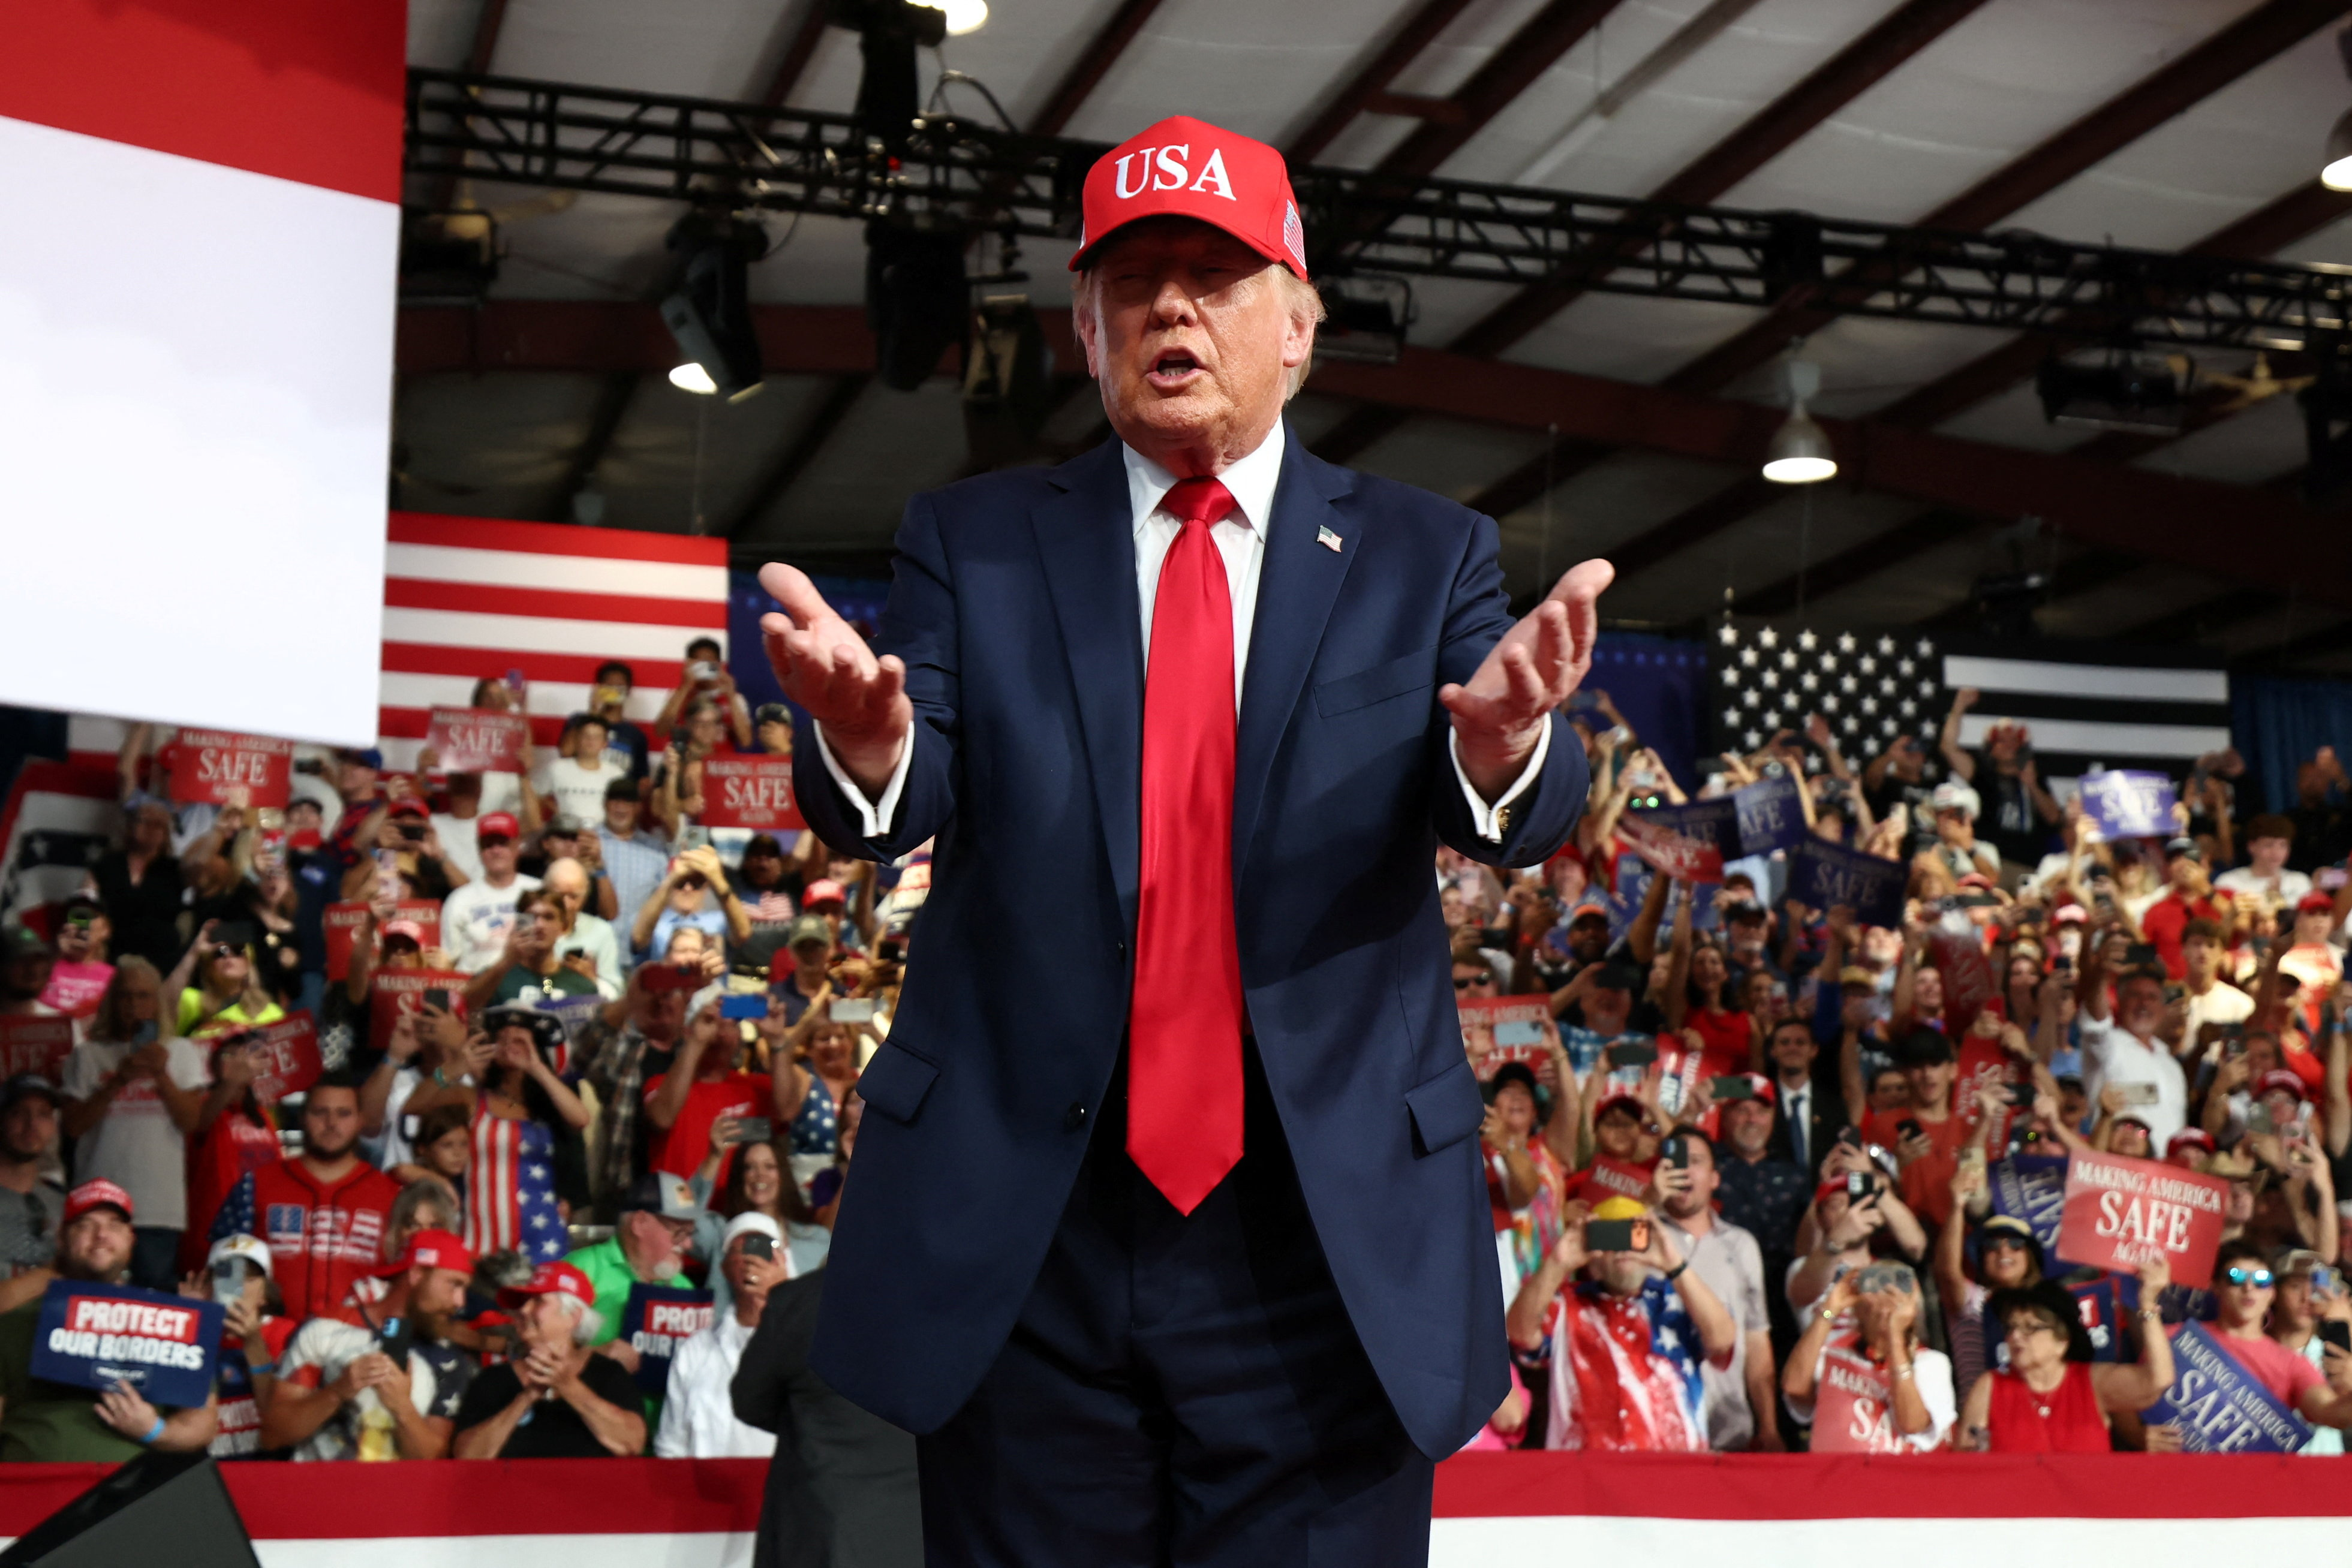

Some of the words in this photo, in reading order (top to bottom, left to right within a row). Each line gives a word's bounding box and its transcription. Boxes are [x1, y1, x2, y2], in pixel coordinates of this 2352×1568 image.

[1115, 143, 1237, 201] USA
[449, 724, 506, 756] SAFE
[197, 748, 267, 787] SAFE
[723, 776, 790, 809] SAFE
[1739, 800, 1785, 836] AFE
[1812, 862, 1878, 905] SAFE
[2019, 1164, 2064, 1250] SAFE
[2073, 1160, 2148, 1194] MAKING
[2146, 1176, 2222, 1214] AMERICA
[2095, 1190, 2193, 1253] SAFE
[74, 1299, 192, 1339] PROTECT
[48, 1327, 98, 1359] OUR
[98, 1334, 205, 1371] BORDERS
[631, 1329, 673, 1358] OUR
[2164, 1368, 2263, 1456] SAFE
[2173, 1330, 2240, 1392] MAKING
[2228, 1384, 2300, 1453] AMERICA
[1849, 1398, 1903, 1455] SA
